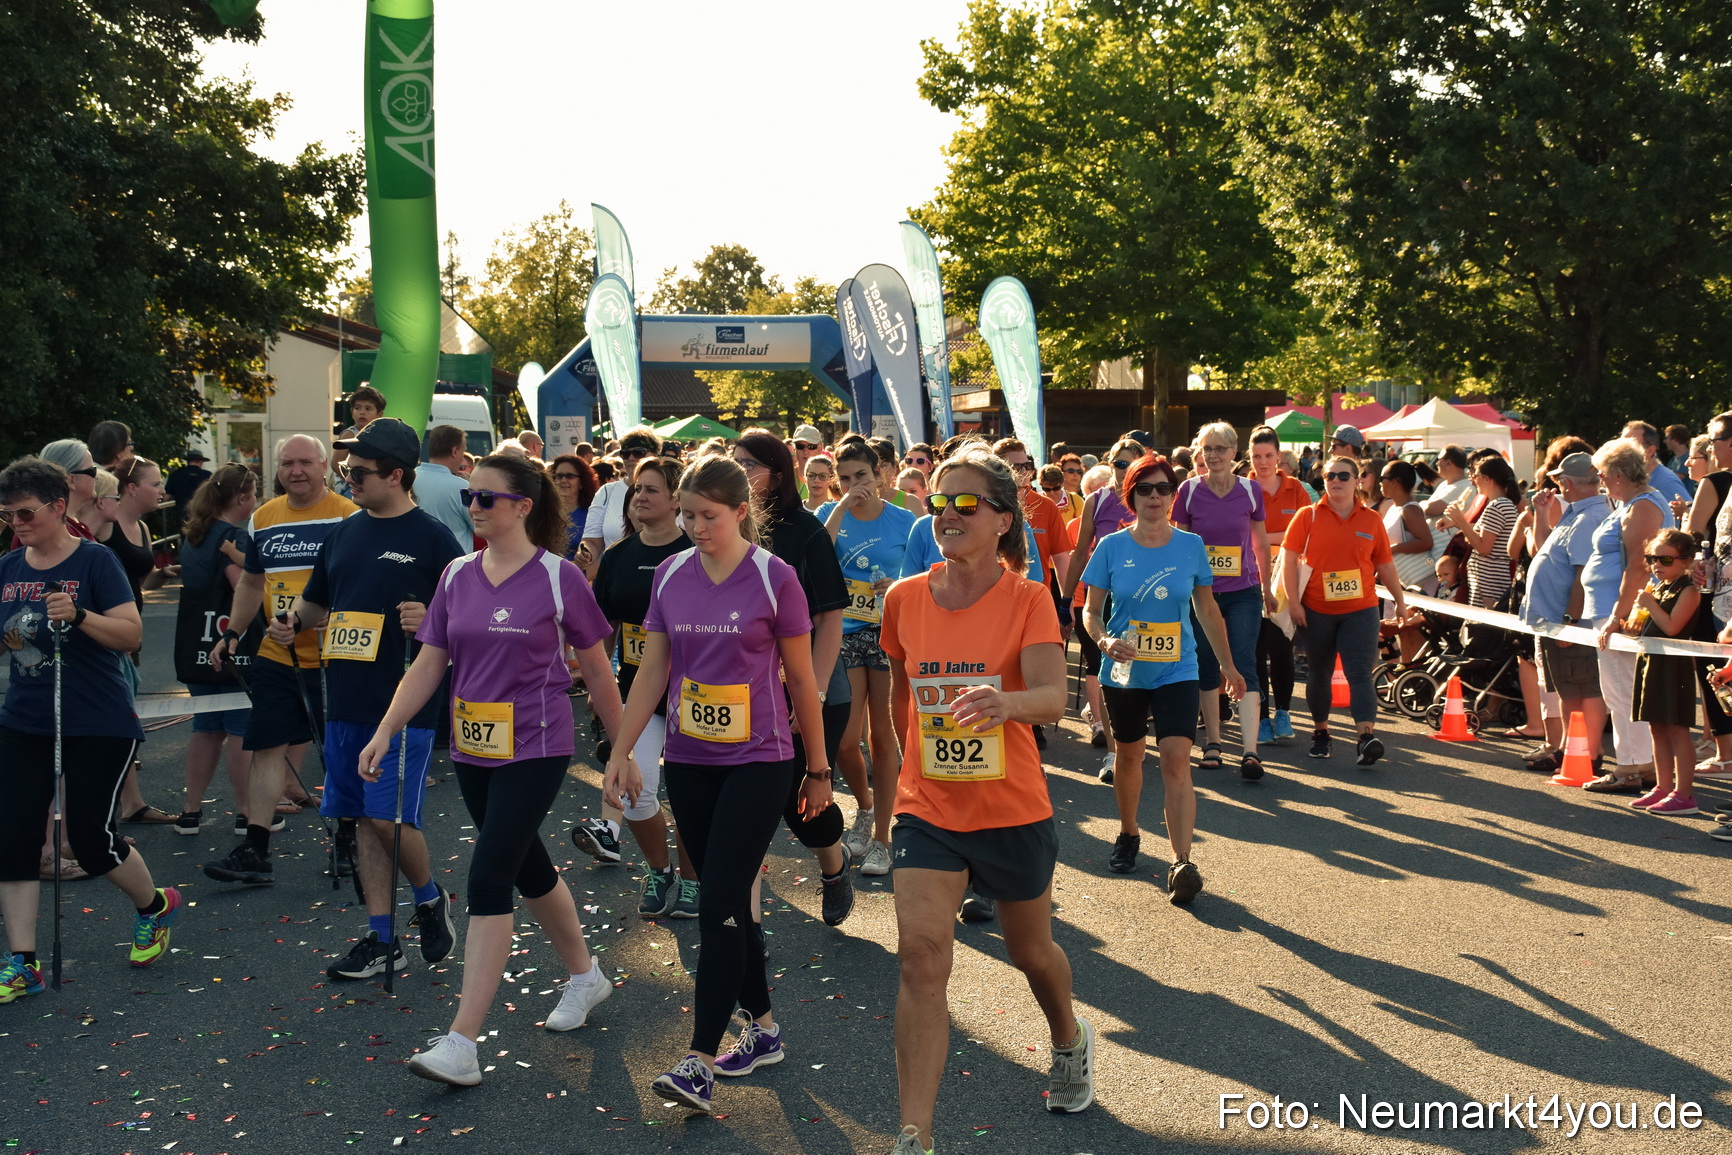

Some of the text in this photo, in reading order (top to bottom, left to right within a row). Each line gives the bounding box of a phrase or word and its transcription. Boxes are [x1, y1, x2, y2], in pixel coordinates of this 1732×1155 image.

[379, 26, 435, 179] AOK
[705, 343, 769, 356] firmenlauf
[270, 541, 323, 553] Fischer
[849, 541, 868, 553] Schick
[274, 551, 318, 559] AUTOMOBILE
[1132, 584, 1146, 600] Team
[1145, 570, 1164, 585] Schick
[1328, 580, 1358, 593] 1483
[488, 626, 530, 634] Fertigteilwerke
[675, 624, 742, 634] WIR SIND LILA.
[331, 628, 373, 647] 1095
[1137, 635, 1174, 651] 1193
[919, 661, 986, 675] 30 Jahre
[691, 702, 732, 727] 688
[462, 719, 495, 743] 687
[935, 738, 984, 763] 892
[933, 762, 957, 770] Zrenner
